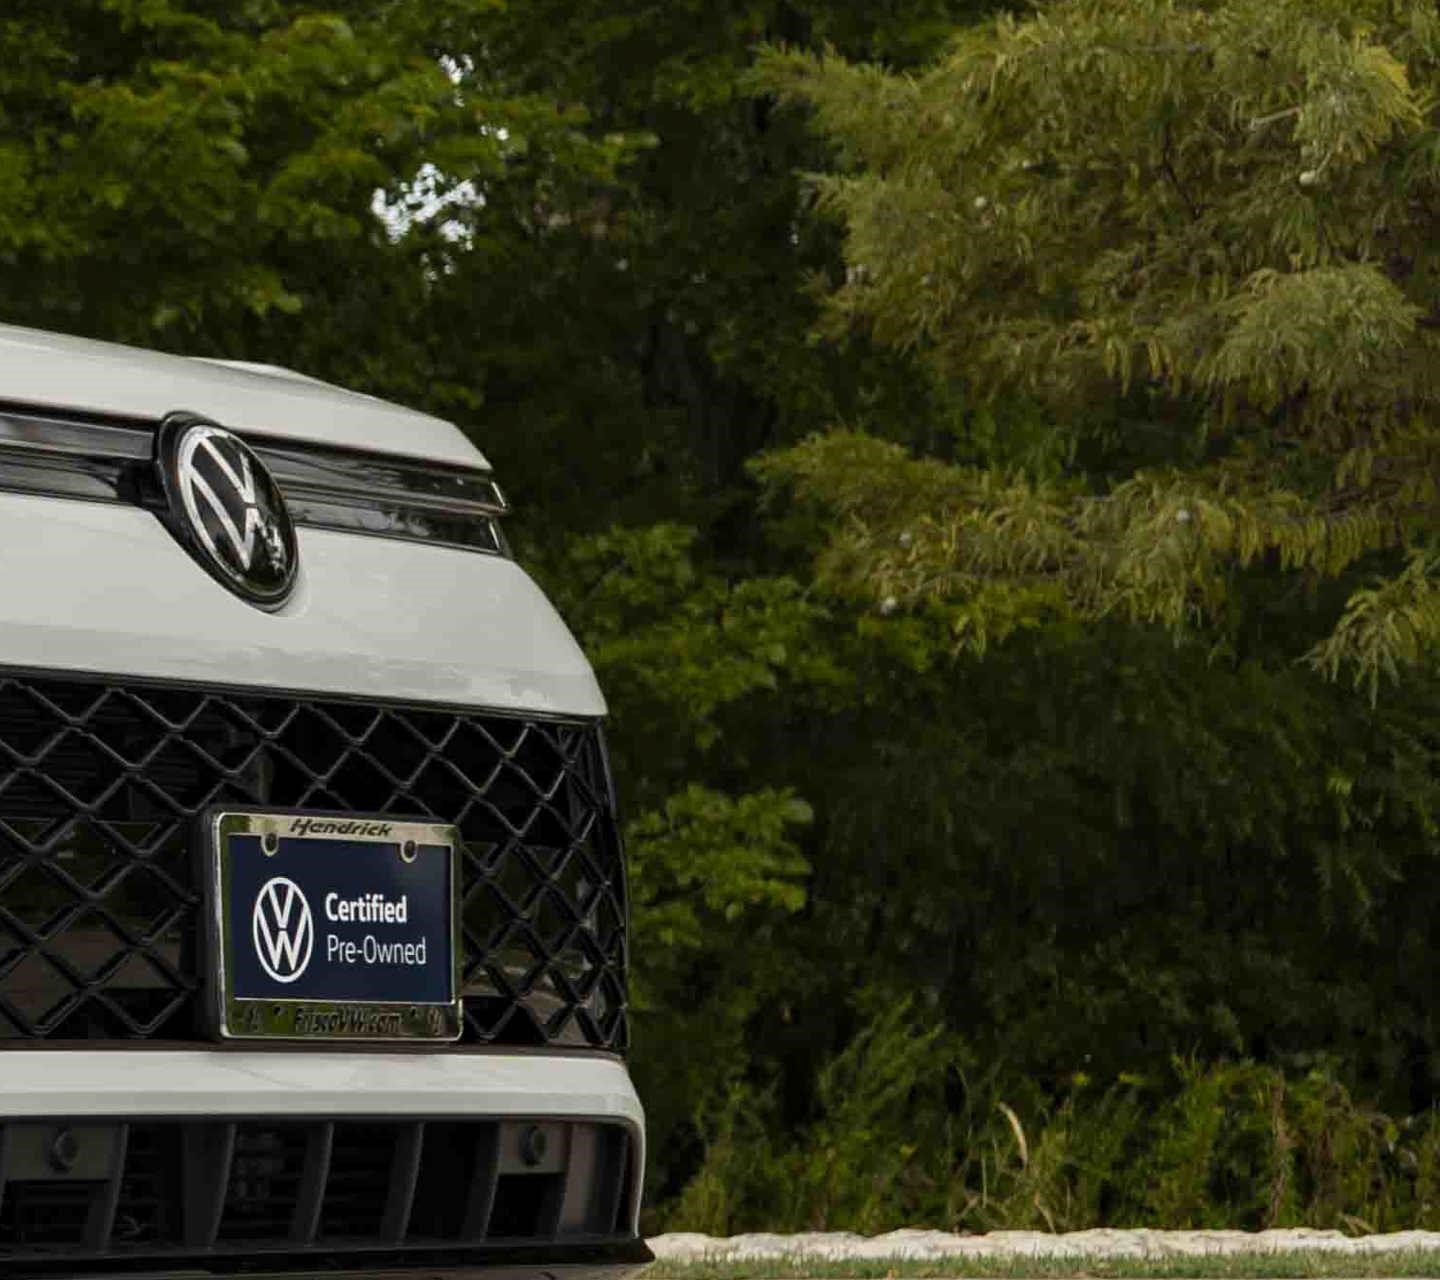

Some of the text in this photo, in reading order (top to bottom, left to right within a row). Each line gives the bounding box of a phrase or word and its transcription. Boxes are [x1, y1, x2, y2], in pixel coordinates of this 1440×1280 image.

[289, 818, 393, 839] Hendrick
[325, 892, 408, 924] Certified
[327, 934, 427, 966] Pre-Owned
